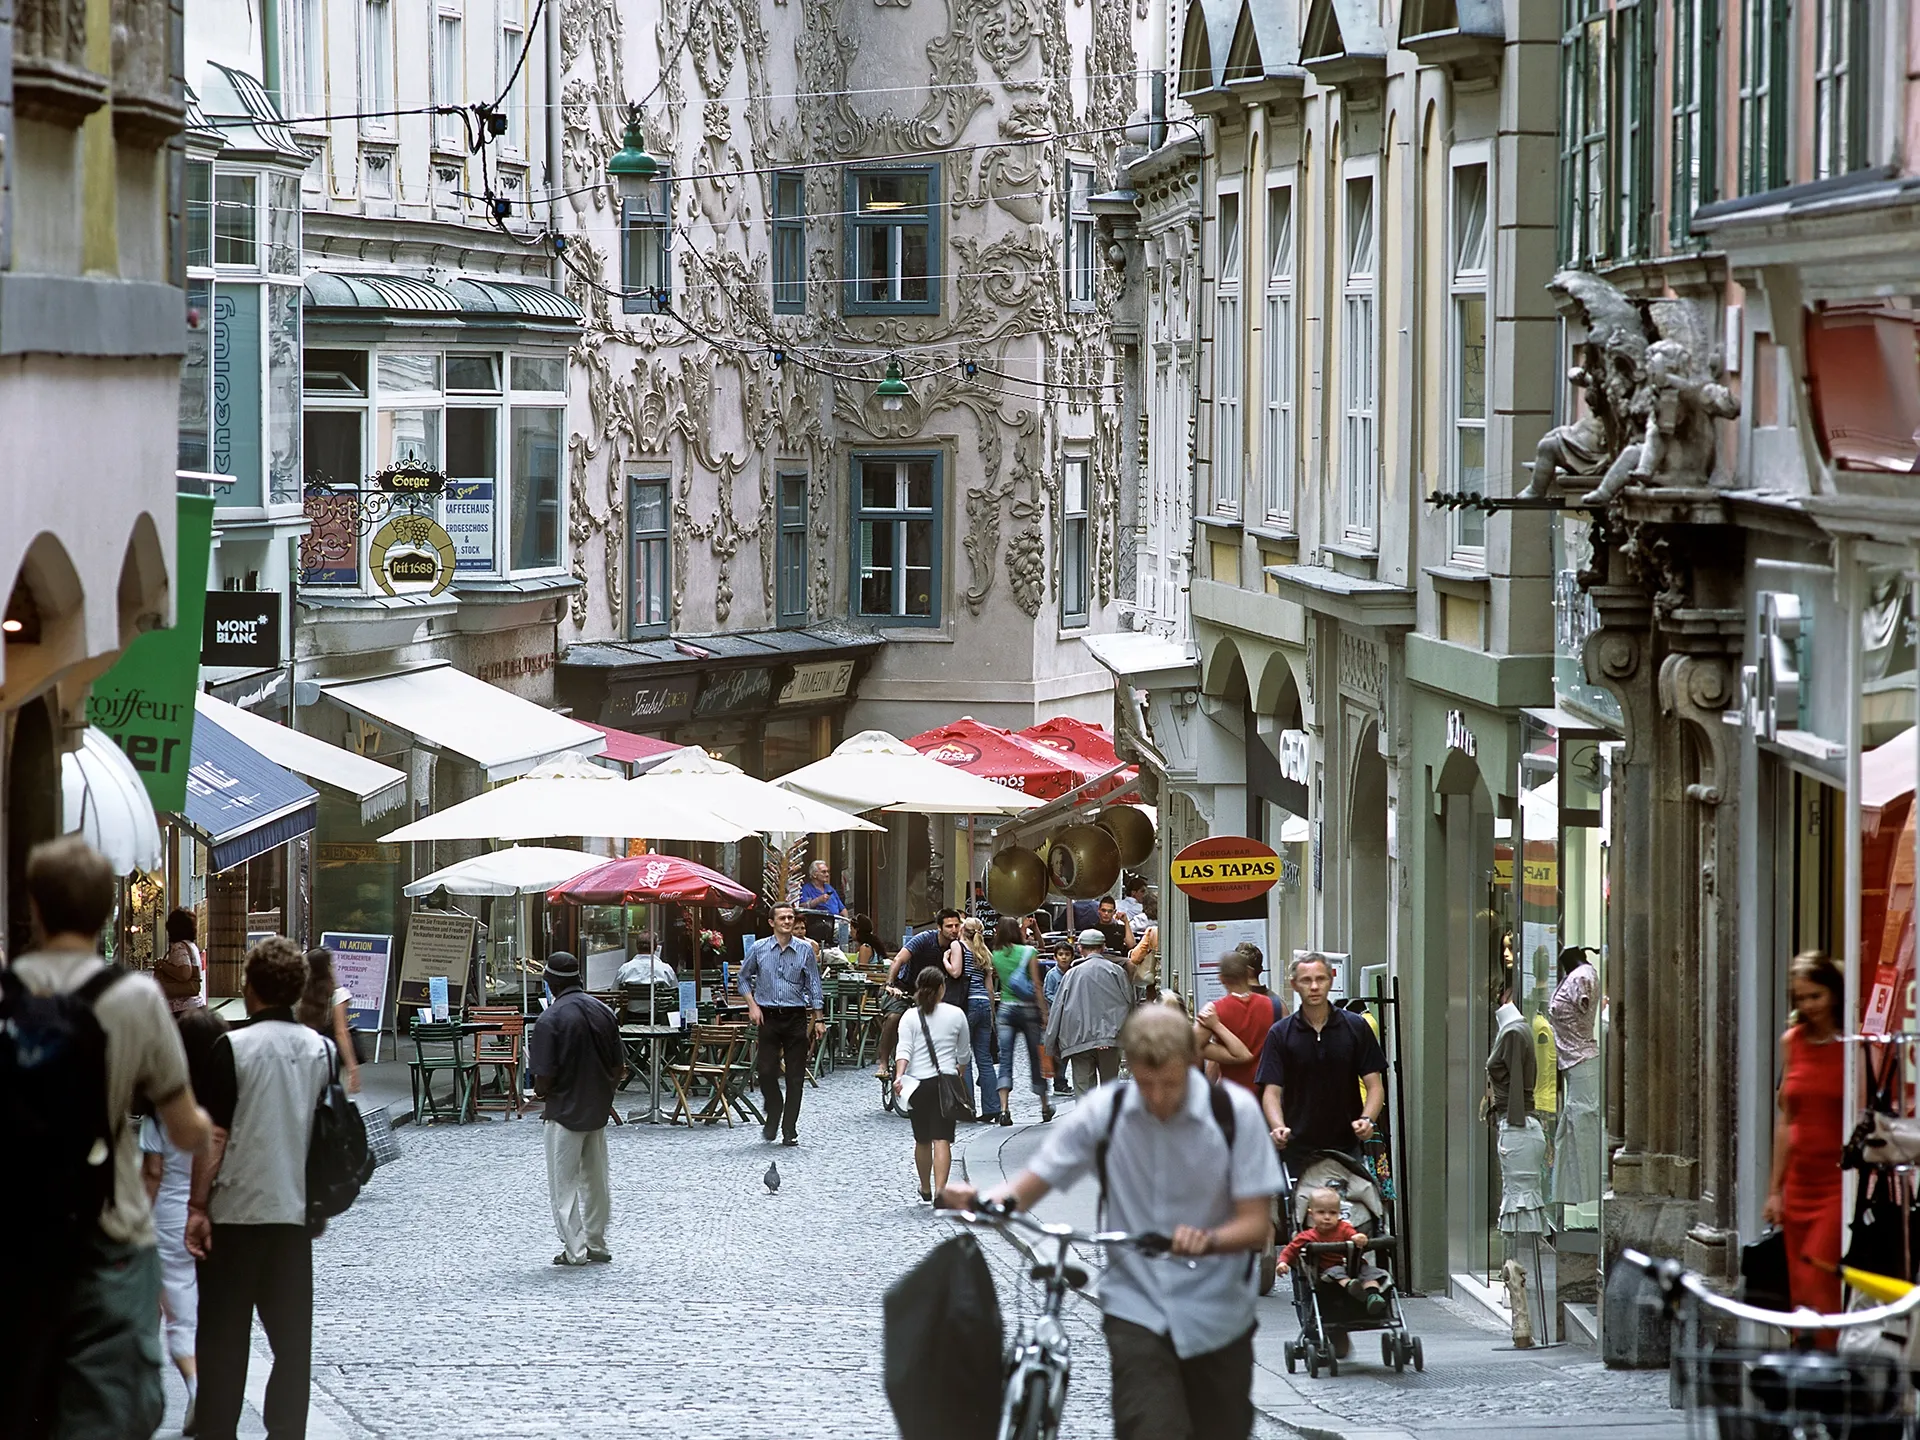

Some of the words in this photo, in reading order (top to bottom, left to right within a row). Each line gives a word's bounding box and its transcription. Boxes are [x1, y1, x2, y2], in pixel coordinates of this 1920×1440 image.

[392, 474, 430, 488] Sorger
[446, 524, 489, 533] ERDGESCHOSS
[464, 535, 470, 544] &
[460, 546, 480, 555] STOCK
[409, 561, 433, 574] 1688
[216, 619, 258, 632] MONT
[216, 632, 257, 644] BLANC
[1180, 864, 1214, 879] LAS
[1218, 862, 1275, 877] TAPAS
[1201, 884, 1252, 892] RESTAURANTE
[339, 940, 347, 949] IN
[348, 940, 373, 951] AKTION
